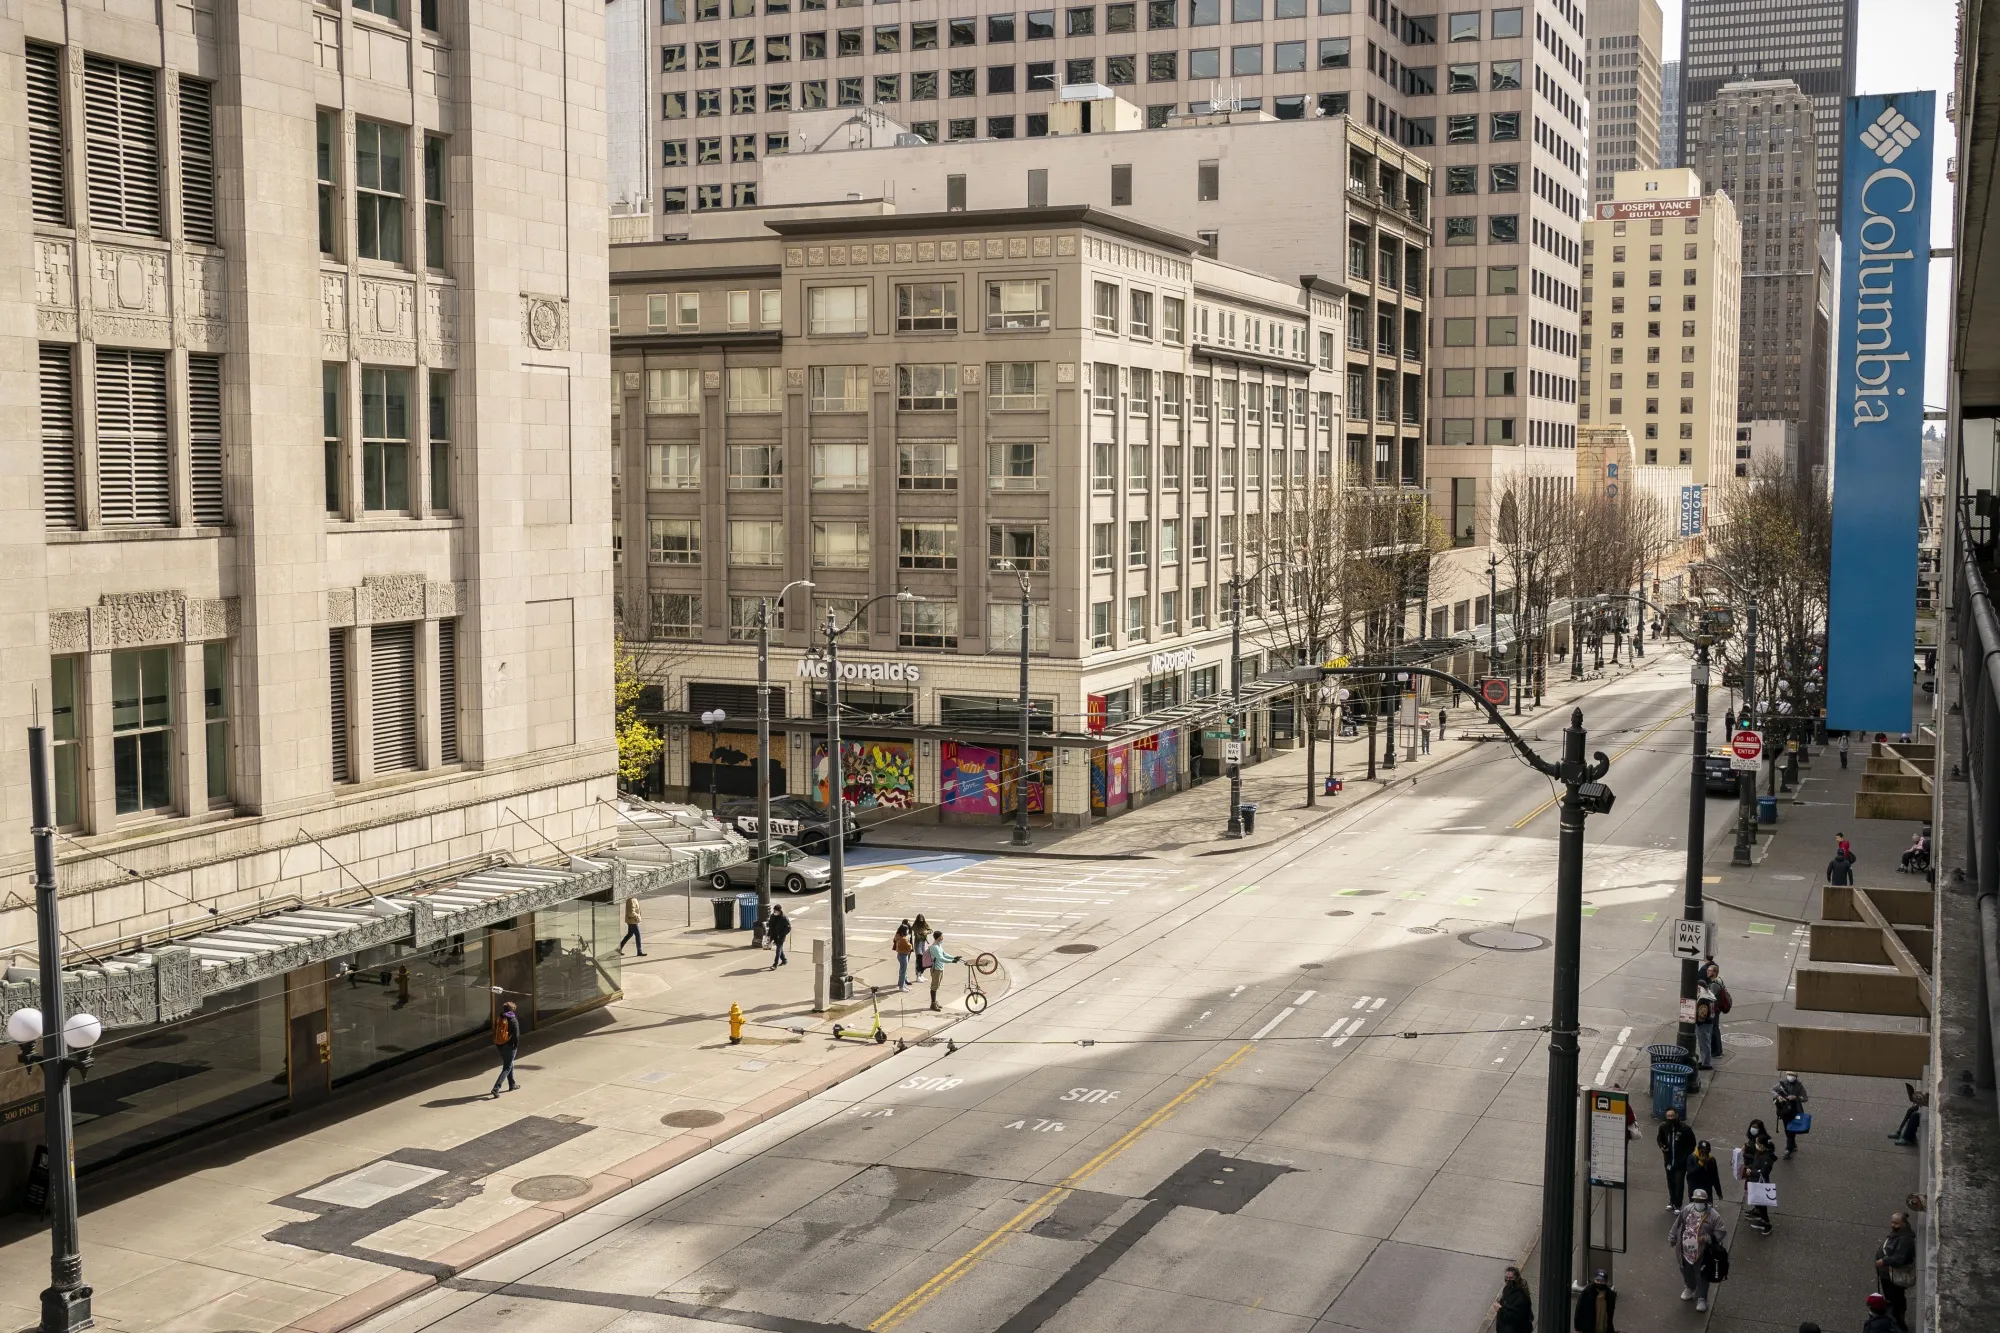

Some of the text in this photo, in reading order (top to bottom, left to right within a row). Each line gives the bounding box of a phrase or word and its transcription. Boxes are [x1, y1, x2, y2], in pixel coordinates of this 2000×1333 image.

[1619, 201, 1692, 212] JOSEPH VANCE
[1629, 210, 1681, 218] BUILDING
[1853, 167, 1916, 428] Columbia
[1681, 491, 1690, 531] ROSS
[1692, 490, 1701, 529] ROSS
[1151, 646, 1197, 673] McDonald's
[748, 821, 795, 834] SRIFF
[1680, 923, 1701, 934] ONE
[1679, 934, 1701, 944] WAY
[898, 1077, 965, 1091] BUS
[4, 1103, 39, 1121] 300 PINE
